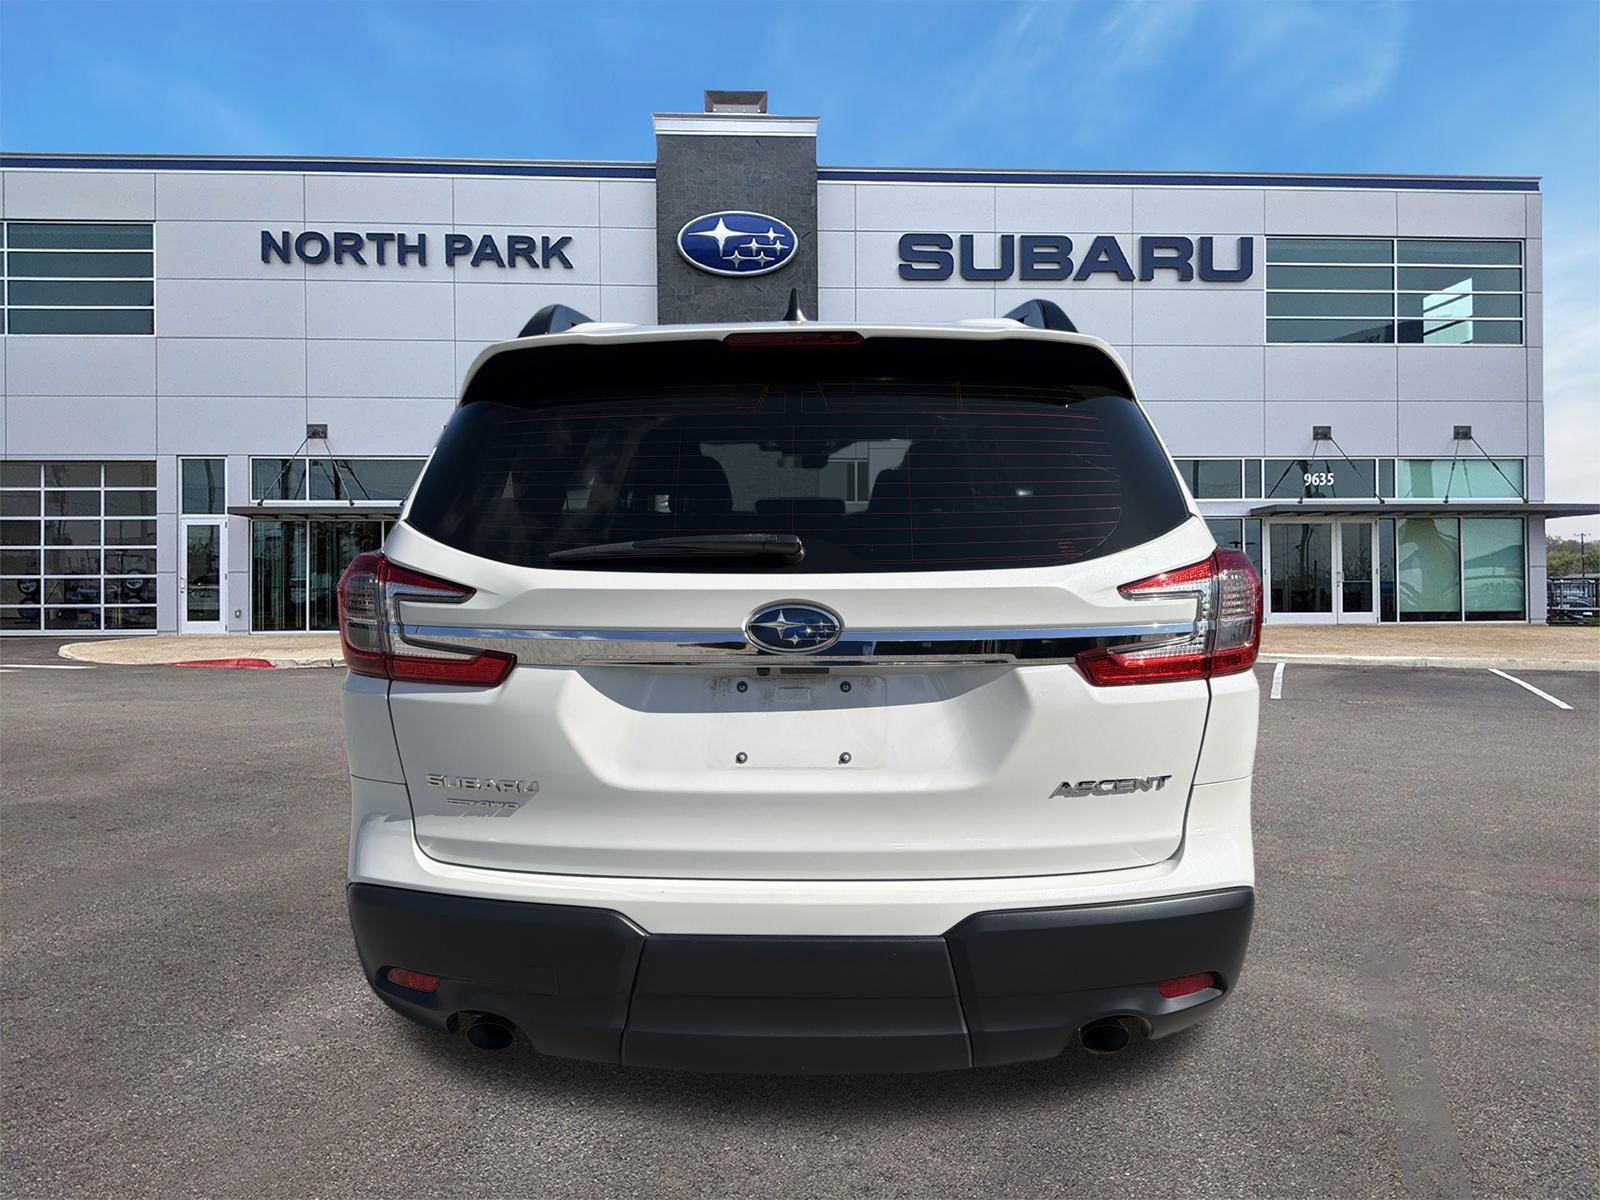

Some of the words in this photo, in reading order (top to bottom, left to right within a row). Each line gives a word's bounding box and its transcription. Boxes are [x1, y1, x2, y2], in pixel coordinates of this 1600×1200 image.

[261, 230, 427, 267] NORTH
[444, 233, 574, 269] PARK
[898, 233, 1254, 282] SUBARU
[1304, 472, 1335, 486] 9635
[426, 774, 540, 793] SUBARU
[1048, 774, 1173, 799] ASCENT
